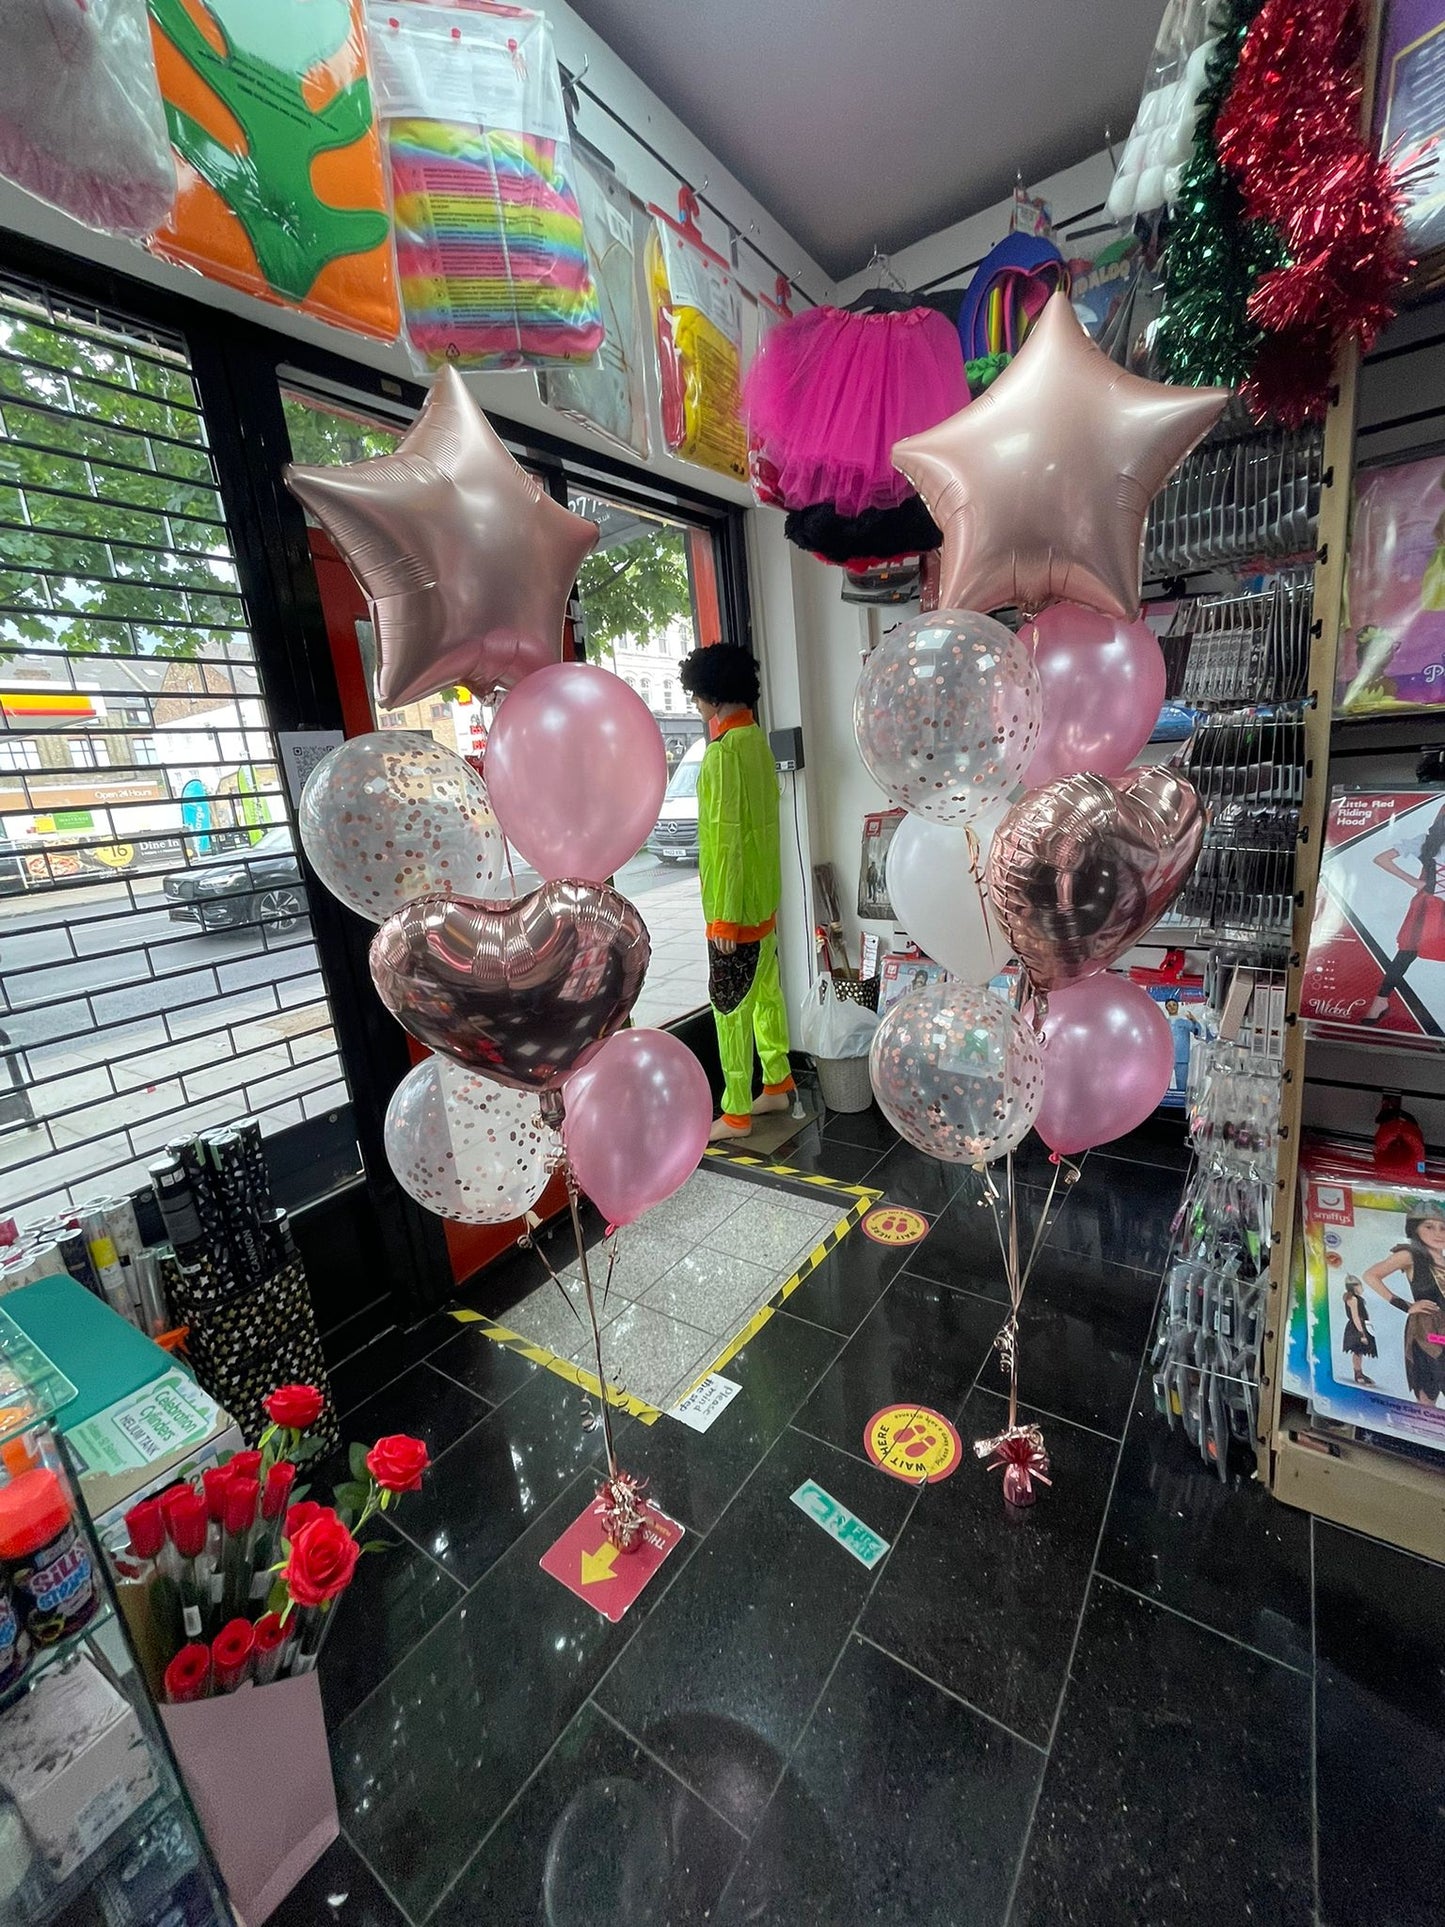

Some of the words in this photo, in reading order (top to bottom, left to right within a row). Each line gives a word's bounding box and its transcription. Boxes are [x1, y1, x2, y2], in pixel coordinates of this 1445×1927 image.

[1423, 664, 1445, 684] P
[95, 791, 117, 800] Open
[128, 788, 152, 797] Hours
[1332, 797, 1369, 808] Little
[1371, 800, 1395, 808] Red
[1338, 808, 1373, 818] Riding
[1336, 817, 1367, 826] Hood
[139, 841, 166, 851] Dine
[167, 839, 180, 847] In
[1308, 998, 1367, 1017] Wicked
[1313, 1211, 1352, 1224] smiffys
[870, 1225, 892, 1239] HERE
[895, 1230, 917, 1240] WAIT
[243, 1229, 261, 1273] CANNON
[697, 1378, 714, 1393] the
[679, 1394, 698, 1412] step
[694, 1387, 717, 1412] mind
[703, 1385, 734, 1416] Please
[1369, 1397, 1402, 1411] Viking
[154, 1390, 197, 1433] Celebration
[140, 1405, 176, 1442] Cylinders
[120, 1414, 145, 1442] HELIUM
[138, 1432, 159, 1457] TANK
[877, 1425, 890, 1455] HERE
[890, 1457, 927, 1472] WAIT
[643, 1530, 665, 1550] THIS
